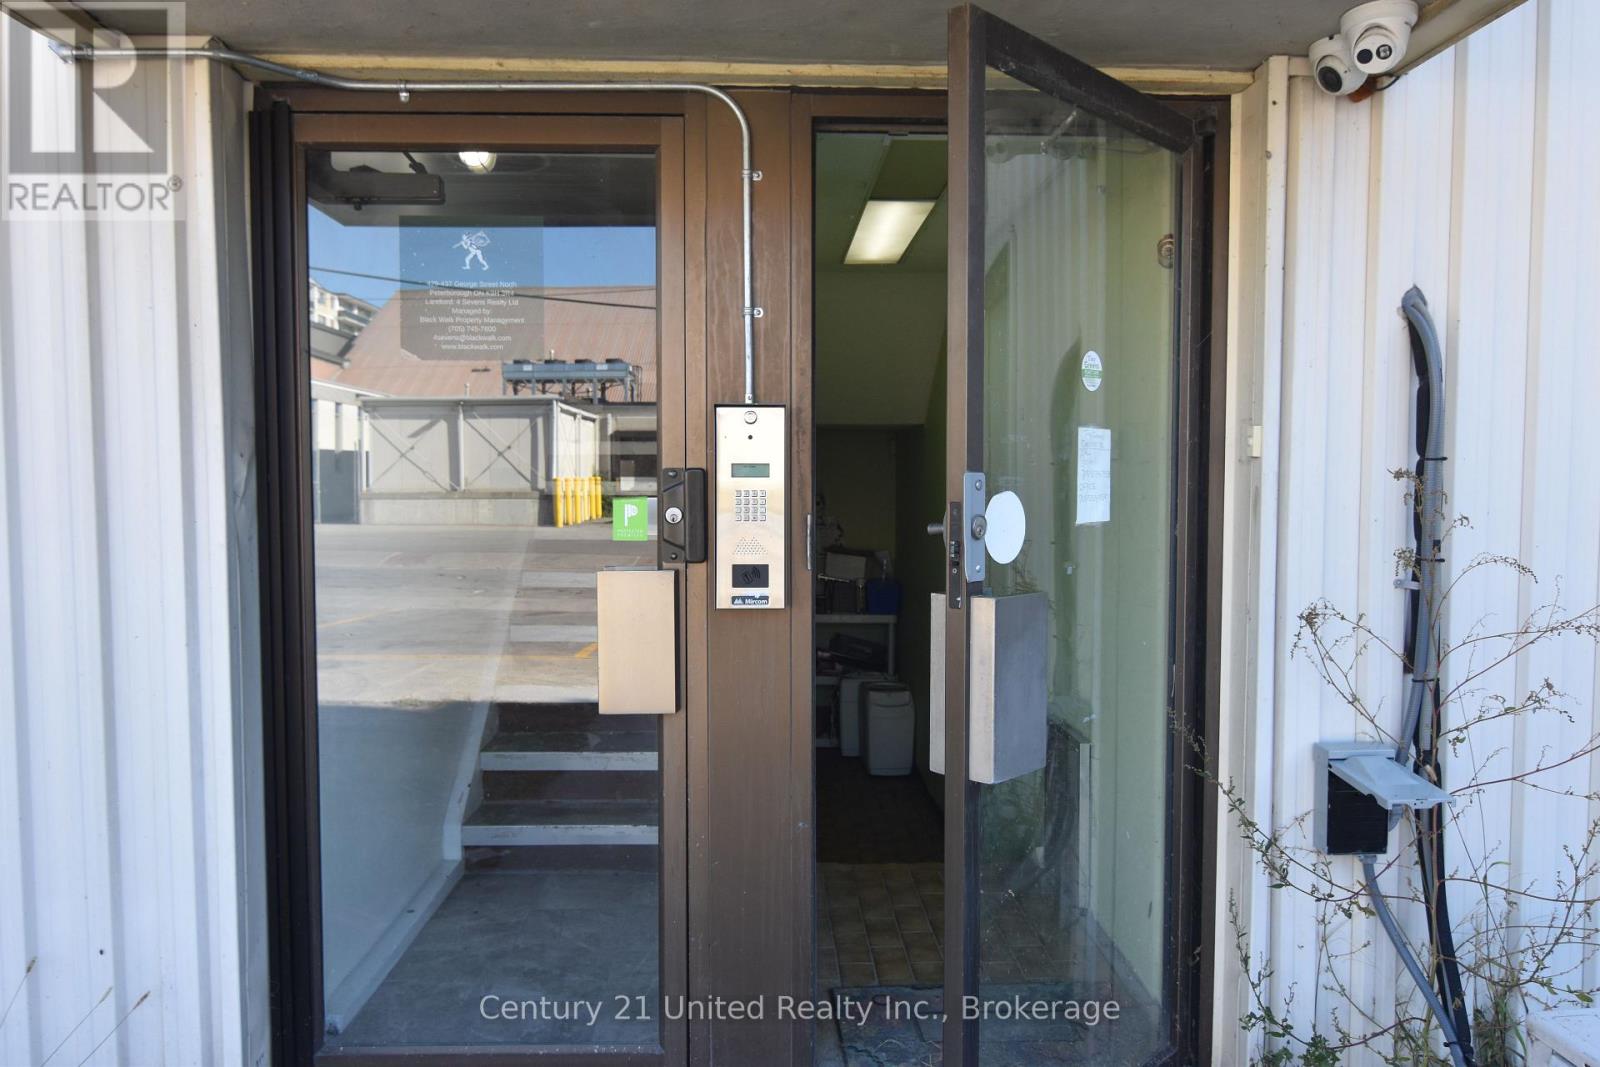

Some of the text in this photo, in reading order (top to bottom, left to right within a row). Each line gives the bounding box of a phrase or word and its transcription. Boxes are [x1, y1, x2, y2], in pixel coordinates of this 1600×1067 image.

[453, 280, 479, 289] George
[499, 280, 517, 288] North
[429, 289, 472, 297] Peterborough
[451, 308, 482, 316] Managed
[455, 316, 482, 325] Property
[483, 316, 525, 325] Management
